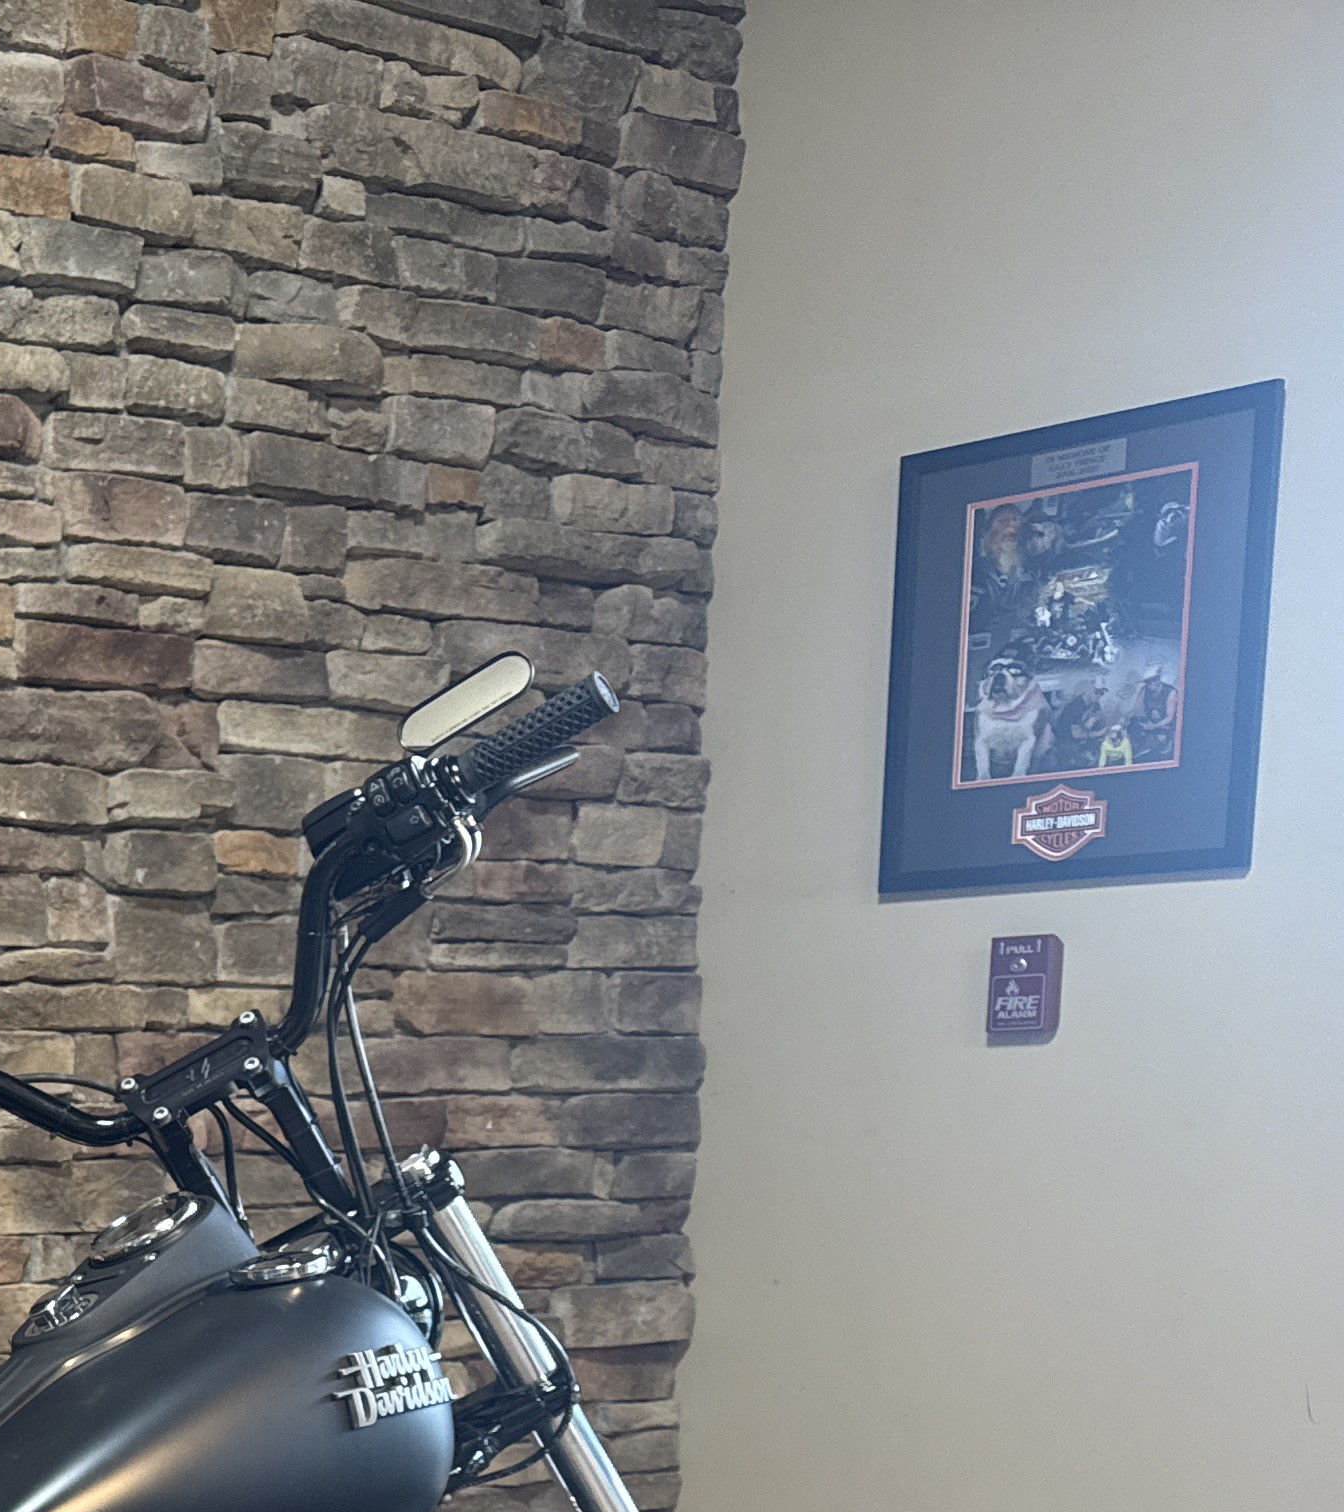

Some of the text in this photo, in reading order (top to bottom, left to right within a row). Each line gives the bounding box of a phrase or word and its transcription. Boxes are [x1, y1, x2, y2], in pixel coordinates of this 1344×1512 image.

[1042, 797, 1081, 813] MOTOR
[1025, 813, 1096, 832] HARLEY-DAVIDSON
[995, 994, 1041, 1012] FIRE
[996, 1010, 1038, 1020] ALARM
[338, 1343, 442, 1390] Harley-
[332, 1371, 461, 1428] Davidson
